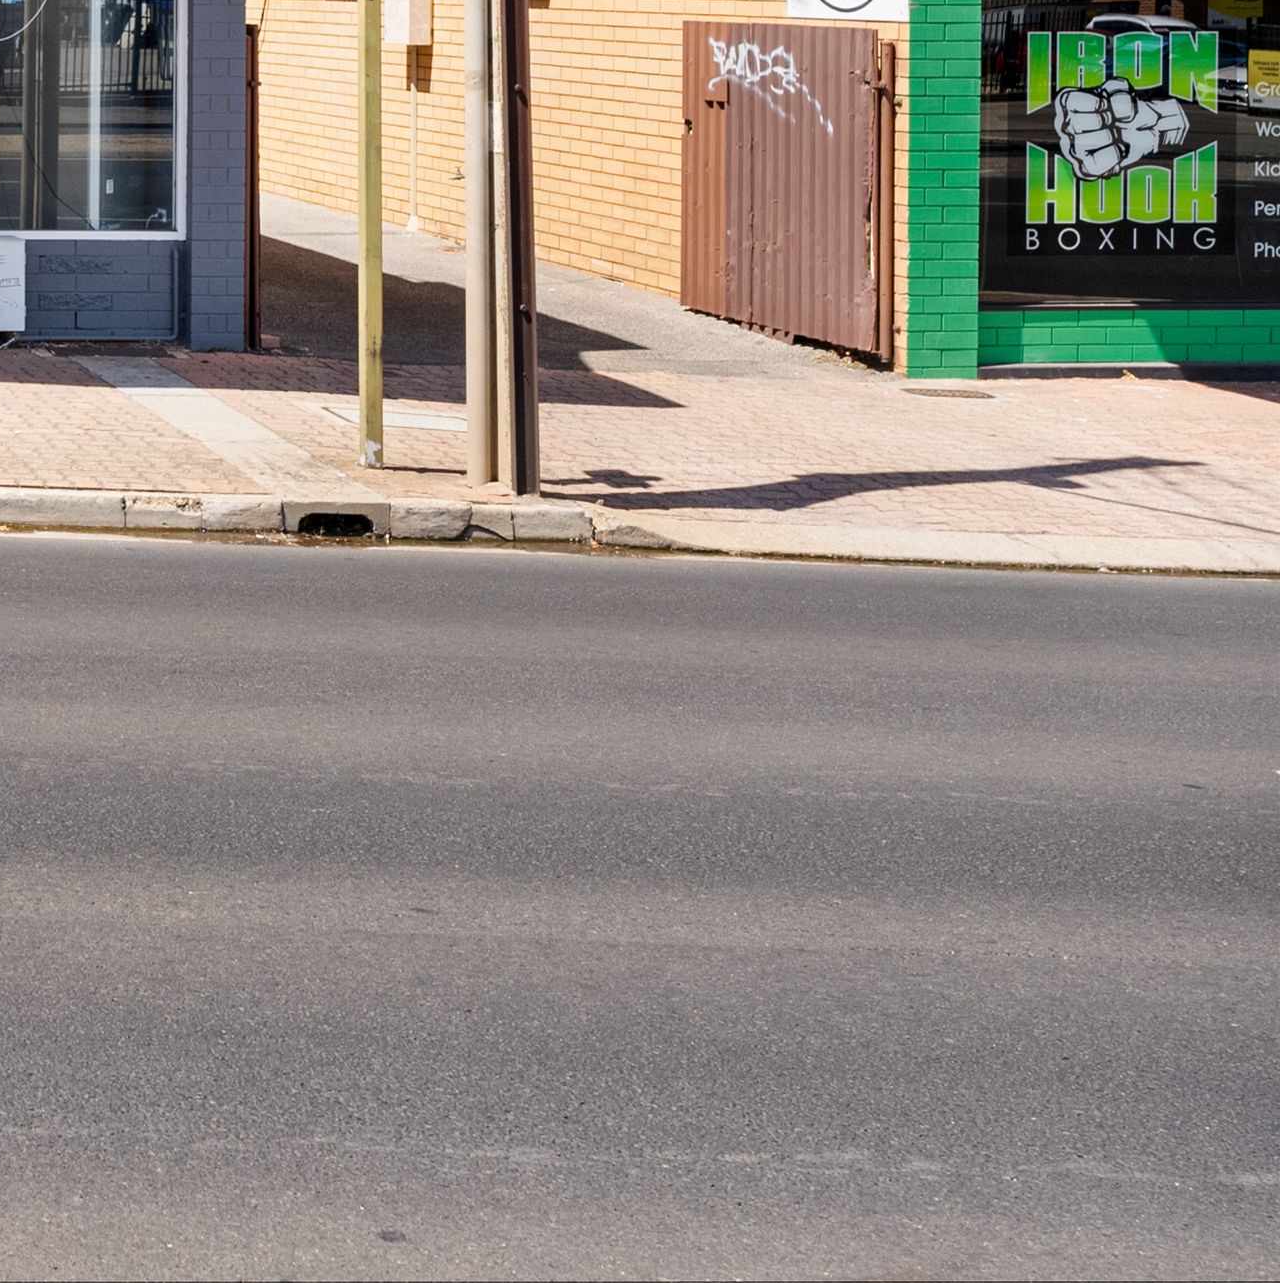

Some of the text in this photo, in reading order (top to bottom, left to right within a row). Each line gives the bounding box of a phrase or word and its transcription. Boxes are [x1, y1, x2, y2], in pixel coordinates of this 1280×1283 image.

[1027, 31, 1219, 115] IRON
[1026, 140, 1217, 224] HOOK
[1026, 227, 1216, 250] BOXING
